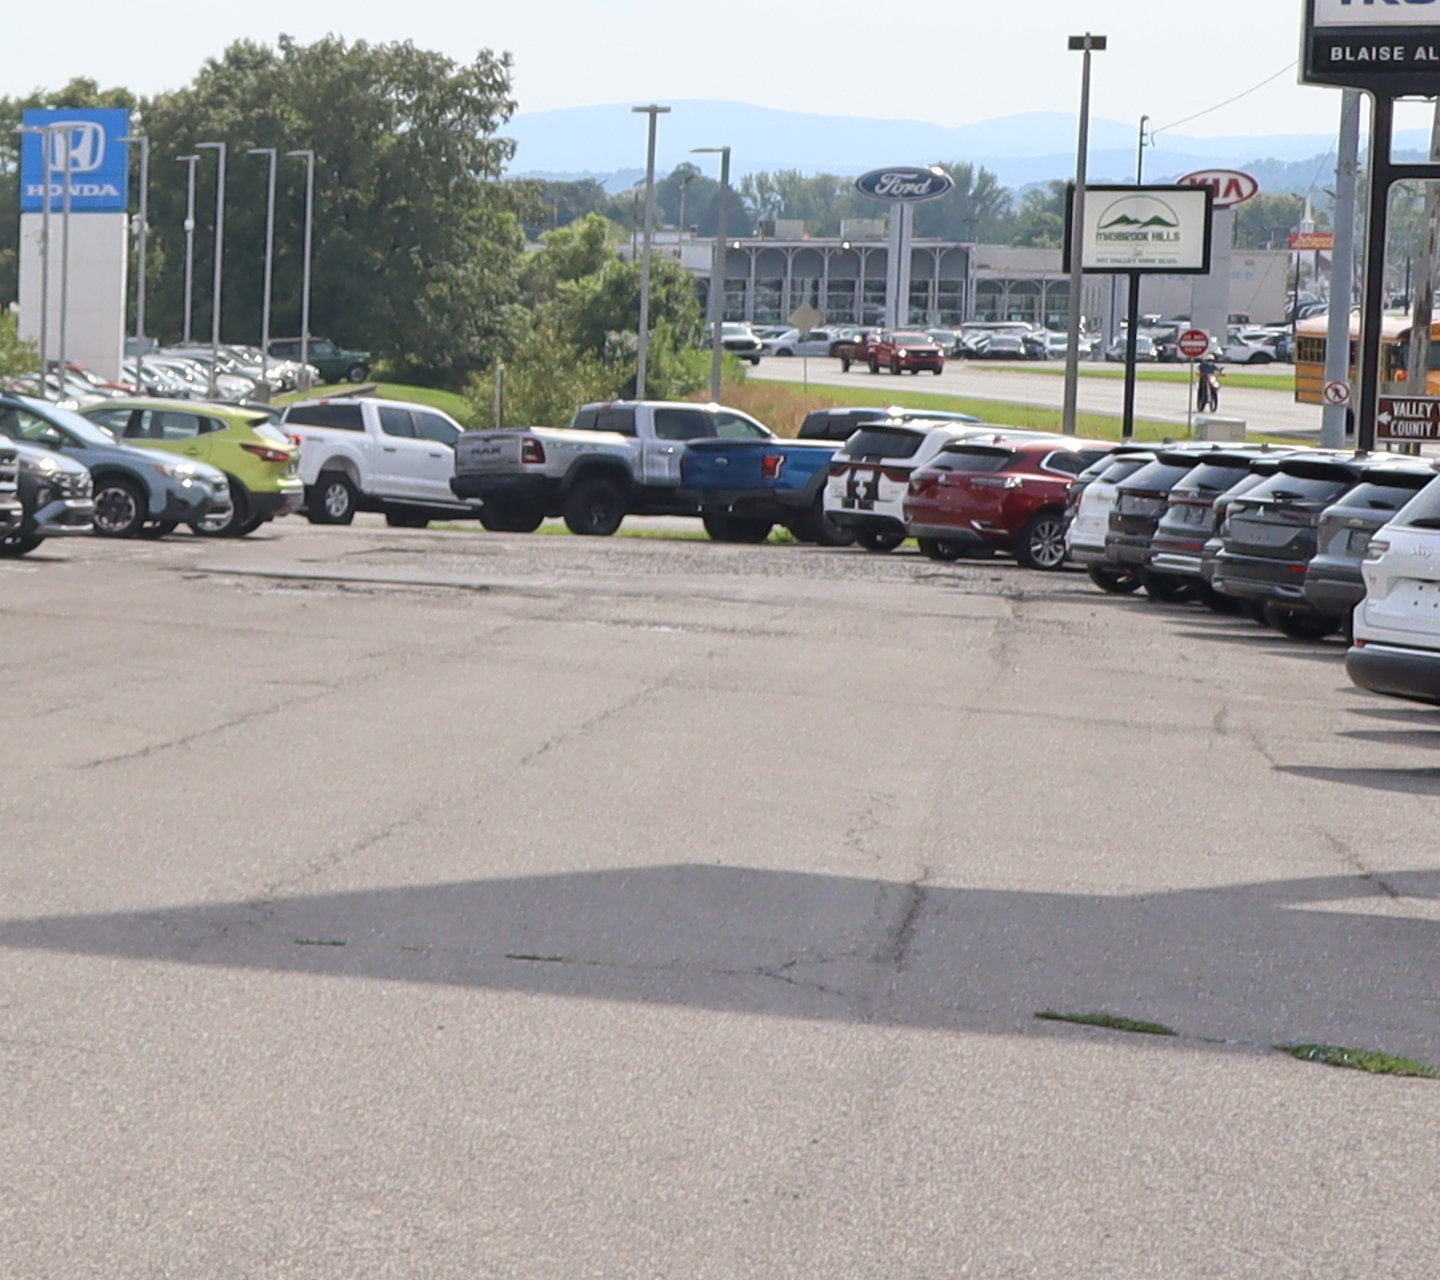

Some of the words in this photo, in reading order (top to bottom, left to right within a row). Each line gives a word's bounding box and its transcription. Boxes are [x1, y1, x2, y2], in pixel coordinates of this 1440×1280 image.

[1330, 46, 1405, 61] BLAISE
[26, 184, 120, 197] HONDA
[874, 173, 932, 195] Ford
[1393, 402, 1433, 418] VALLEY
[1391, 420, 1432, 437] COUNTY
